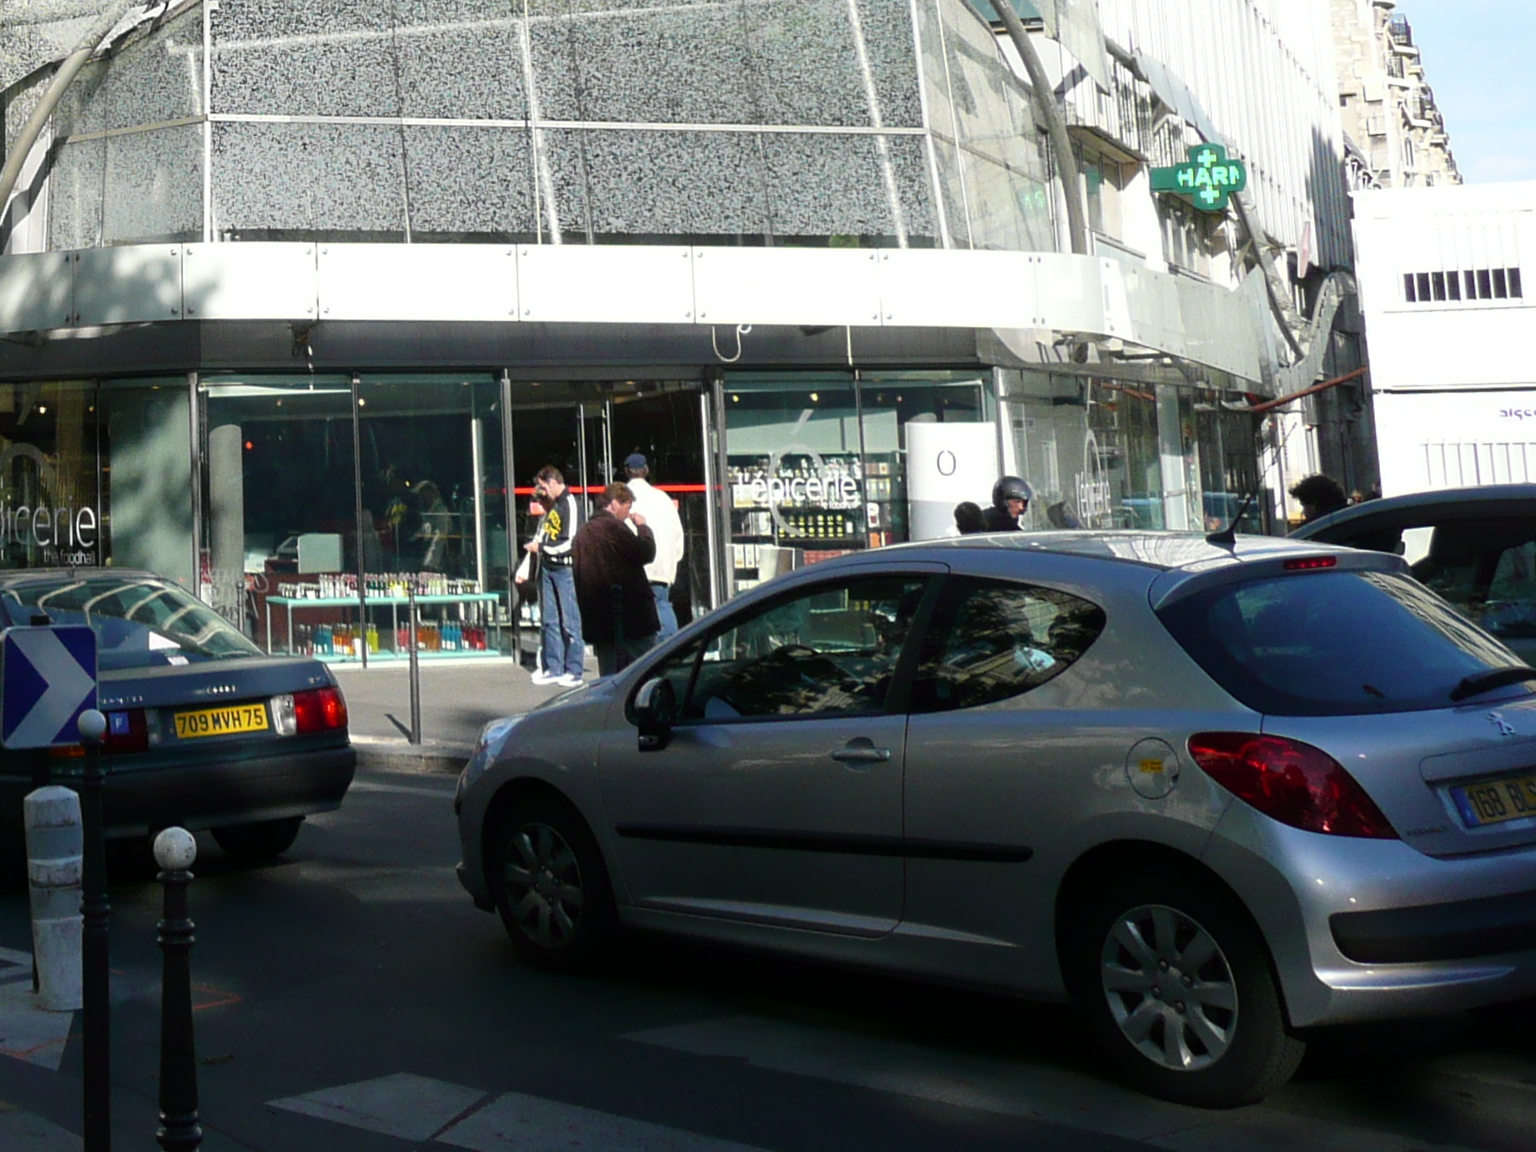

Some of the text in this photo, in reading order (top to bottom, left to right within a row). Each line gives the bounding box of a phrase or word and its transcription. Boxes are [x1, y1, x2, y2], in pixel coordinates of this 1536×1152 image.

[177, 708, 265, 735] 709 MVH 75
[1467, 789, 1507, 819] 168
